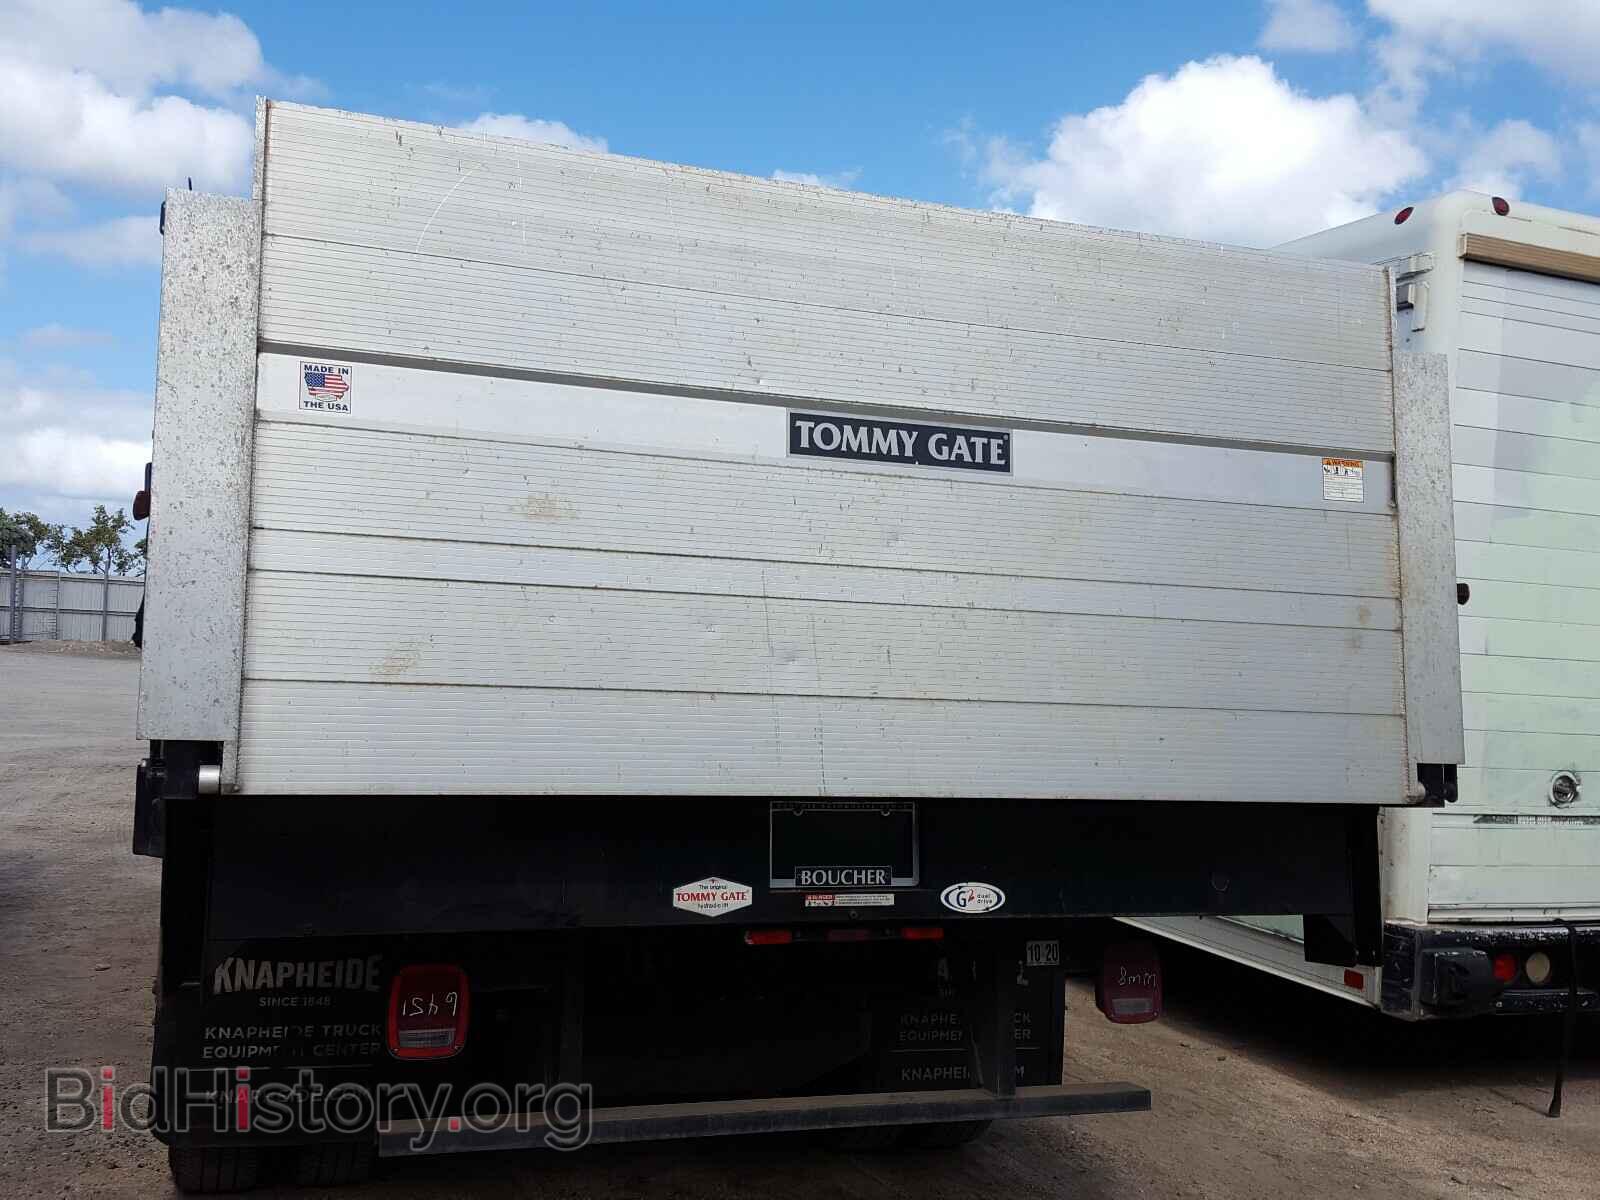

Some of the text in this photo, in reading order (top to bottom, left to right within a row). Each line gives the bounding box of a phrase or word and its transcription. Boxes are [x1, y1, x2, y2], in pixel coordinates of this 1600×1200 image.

[304, 365, 349, 375] MADE IN
[304, 400, 349, 411] THE USA
[795, 420, 918, 457] TOMMY
[800, 869, 886, 886] BOUCHER
[676, 891, 748, 902] TOMMY GATE
[1046, 943, 1058, 961] 20
[212, 953, 383, 994] KNAPHEIDE
[257, 997, 296, 1008] SINCE
[320, 1024, 382, 1038] TRUCK
